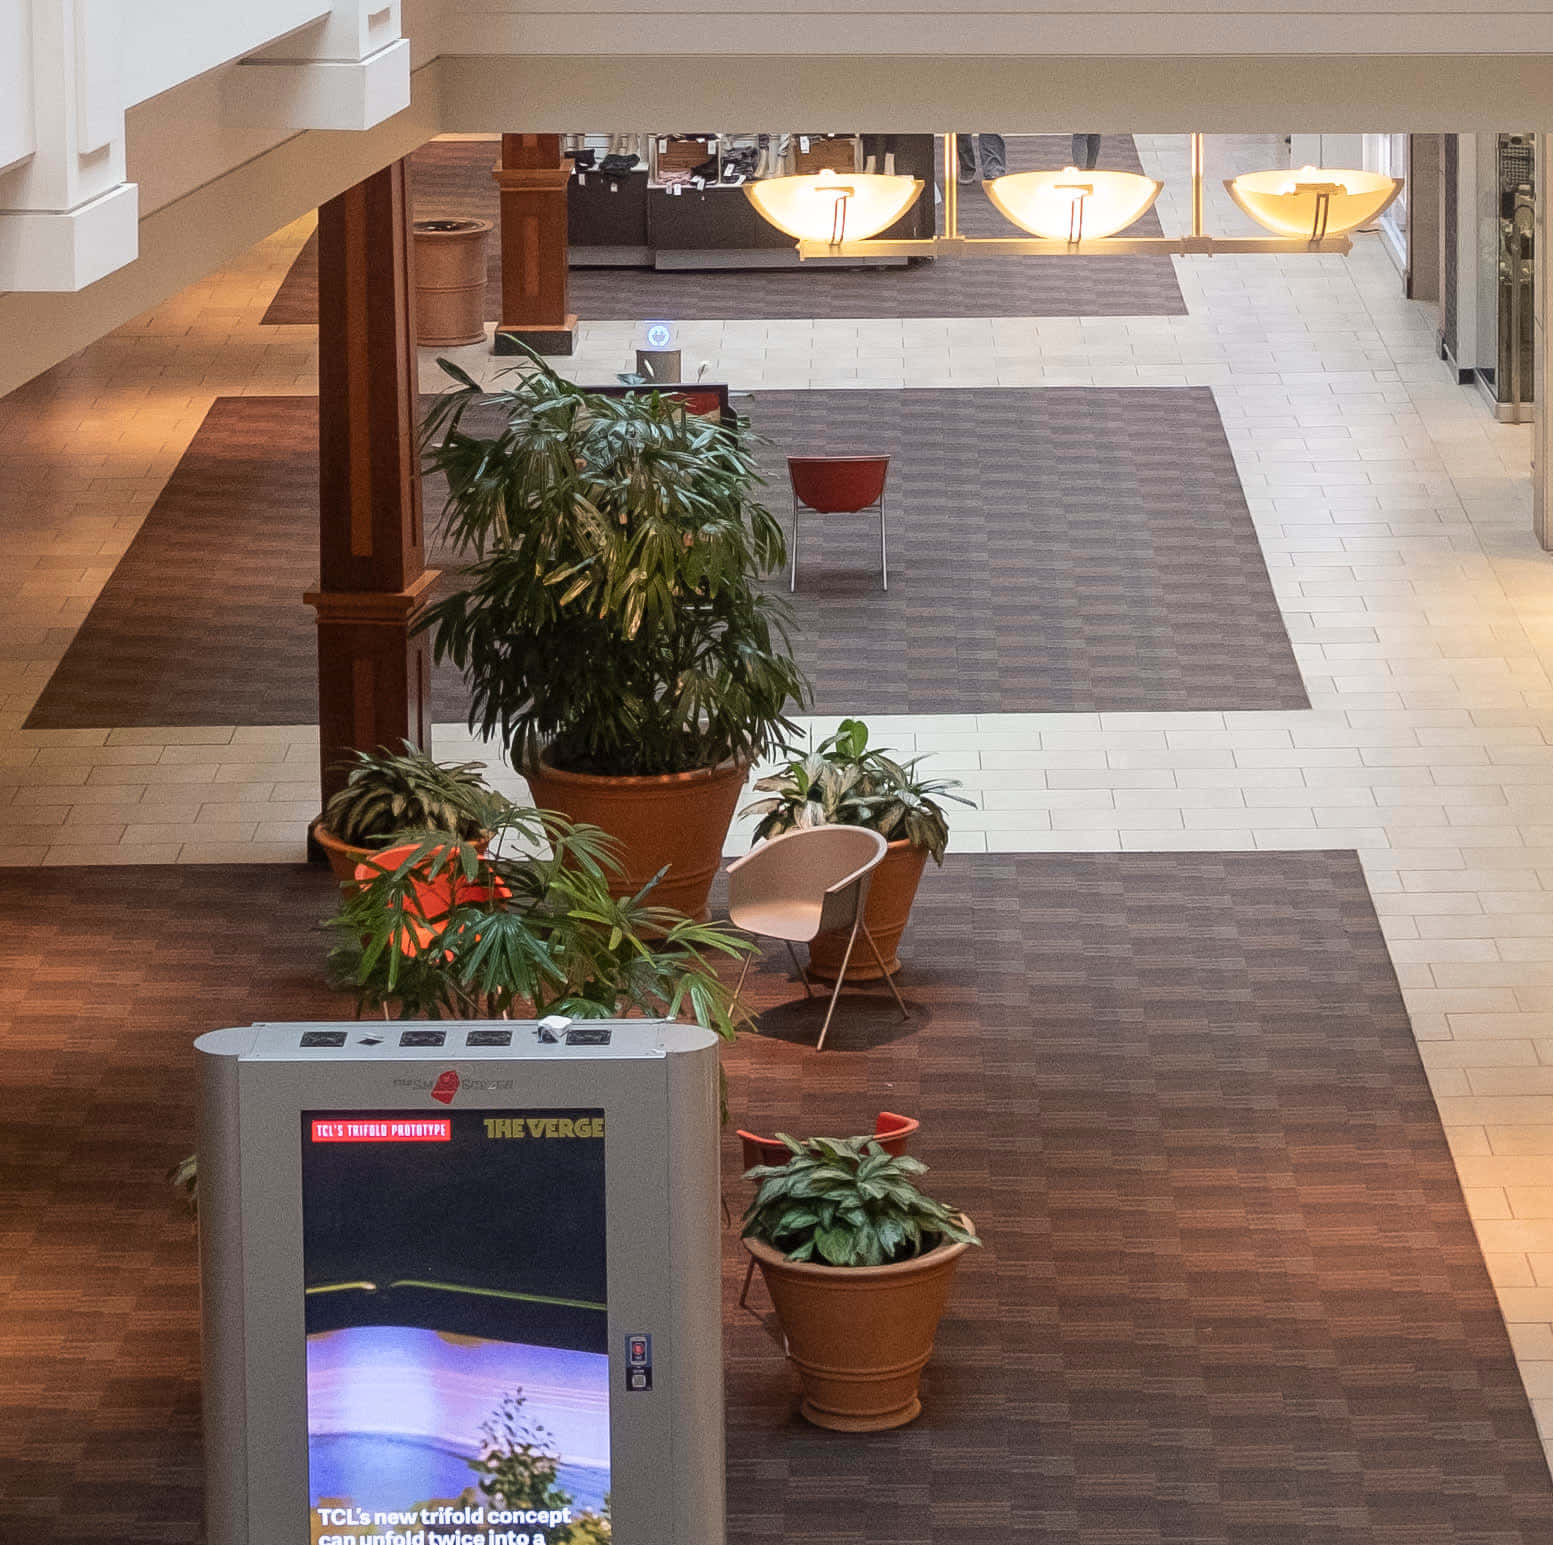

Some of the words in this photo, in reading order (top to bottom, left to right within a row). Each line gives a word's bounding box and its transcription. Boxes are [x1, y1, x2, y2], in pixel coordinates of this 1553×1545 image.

[316, 1124, 344, 1137] TCL'S
[347, 1124, 388, 1137] TRIFOLD
[391, 1123, 446, 1137] PROTOTYPE
[484, 1118, 531, 1139] THE
[530, 1118, 605, 1139] VERGE
[317, 1508, 371, 1526] TCL's
[374, 1512, 418, 1525] new
[420, 1507, 484, 1525] trifold
[487, 1508, 572, 1528] concept
[318, 1534, 357, 1545] can
[359, 1530, 425, 1545] unfold
[427, 1530, 485, 1545] twice
[488, 1530, 530, 1545] into
[532, 1534, 546, 1545] a
